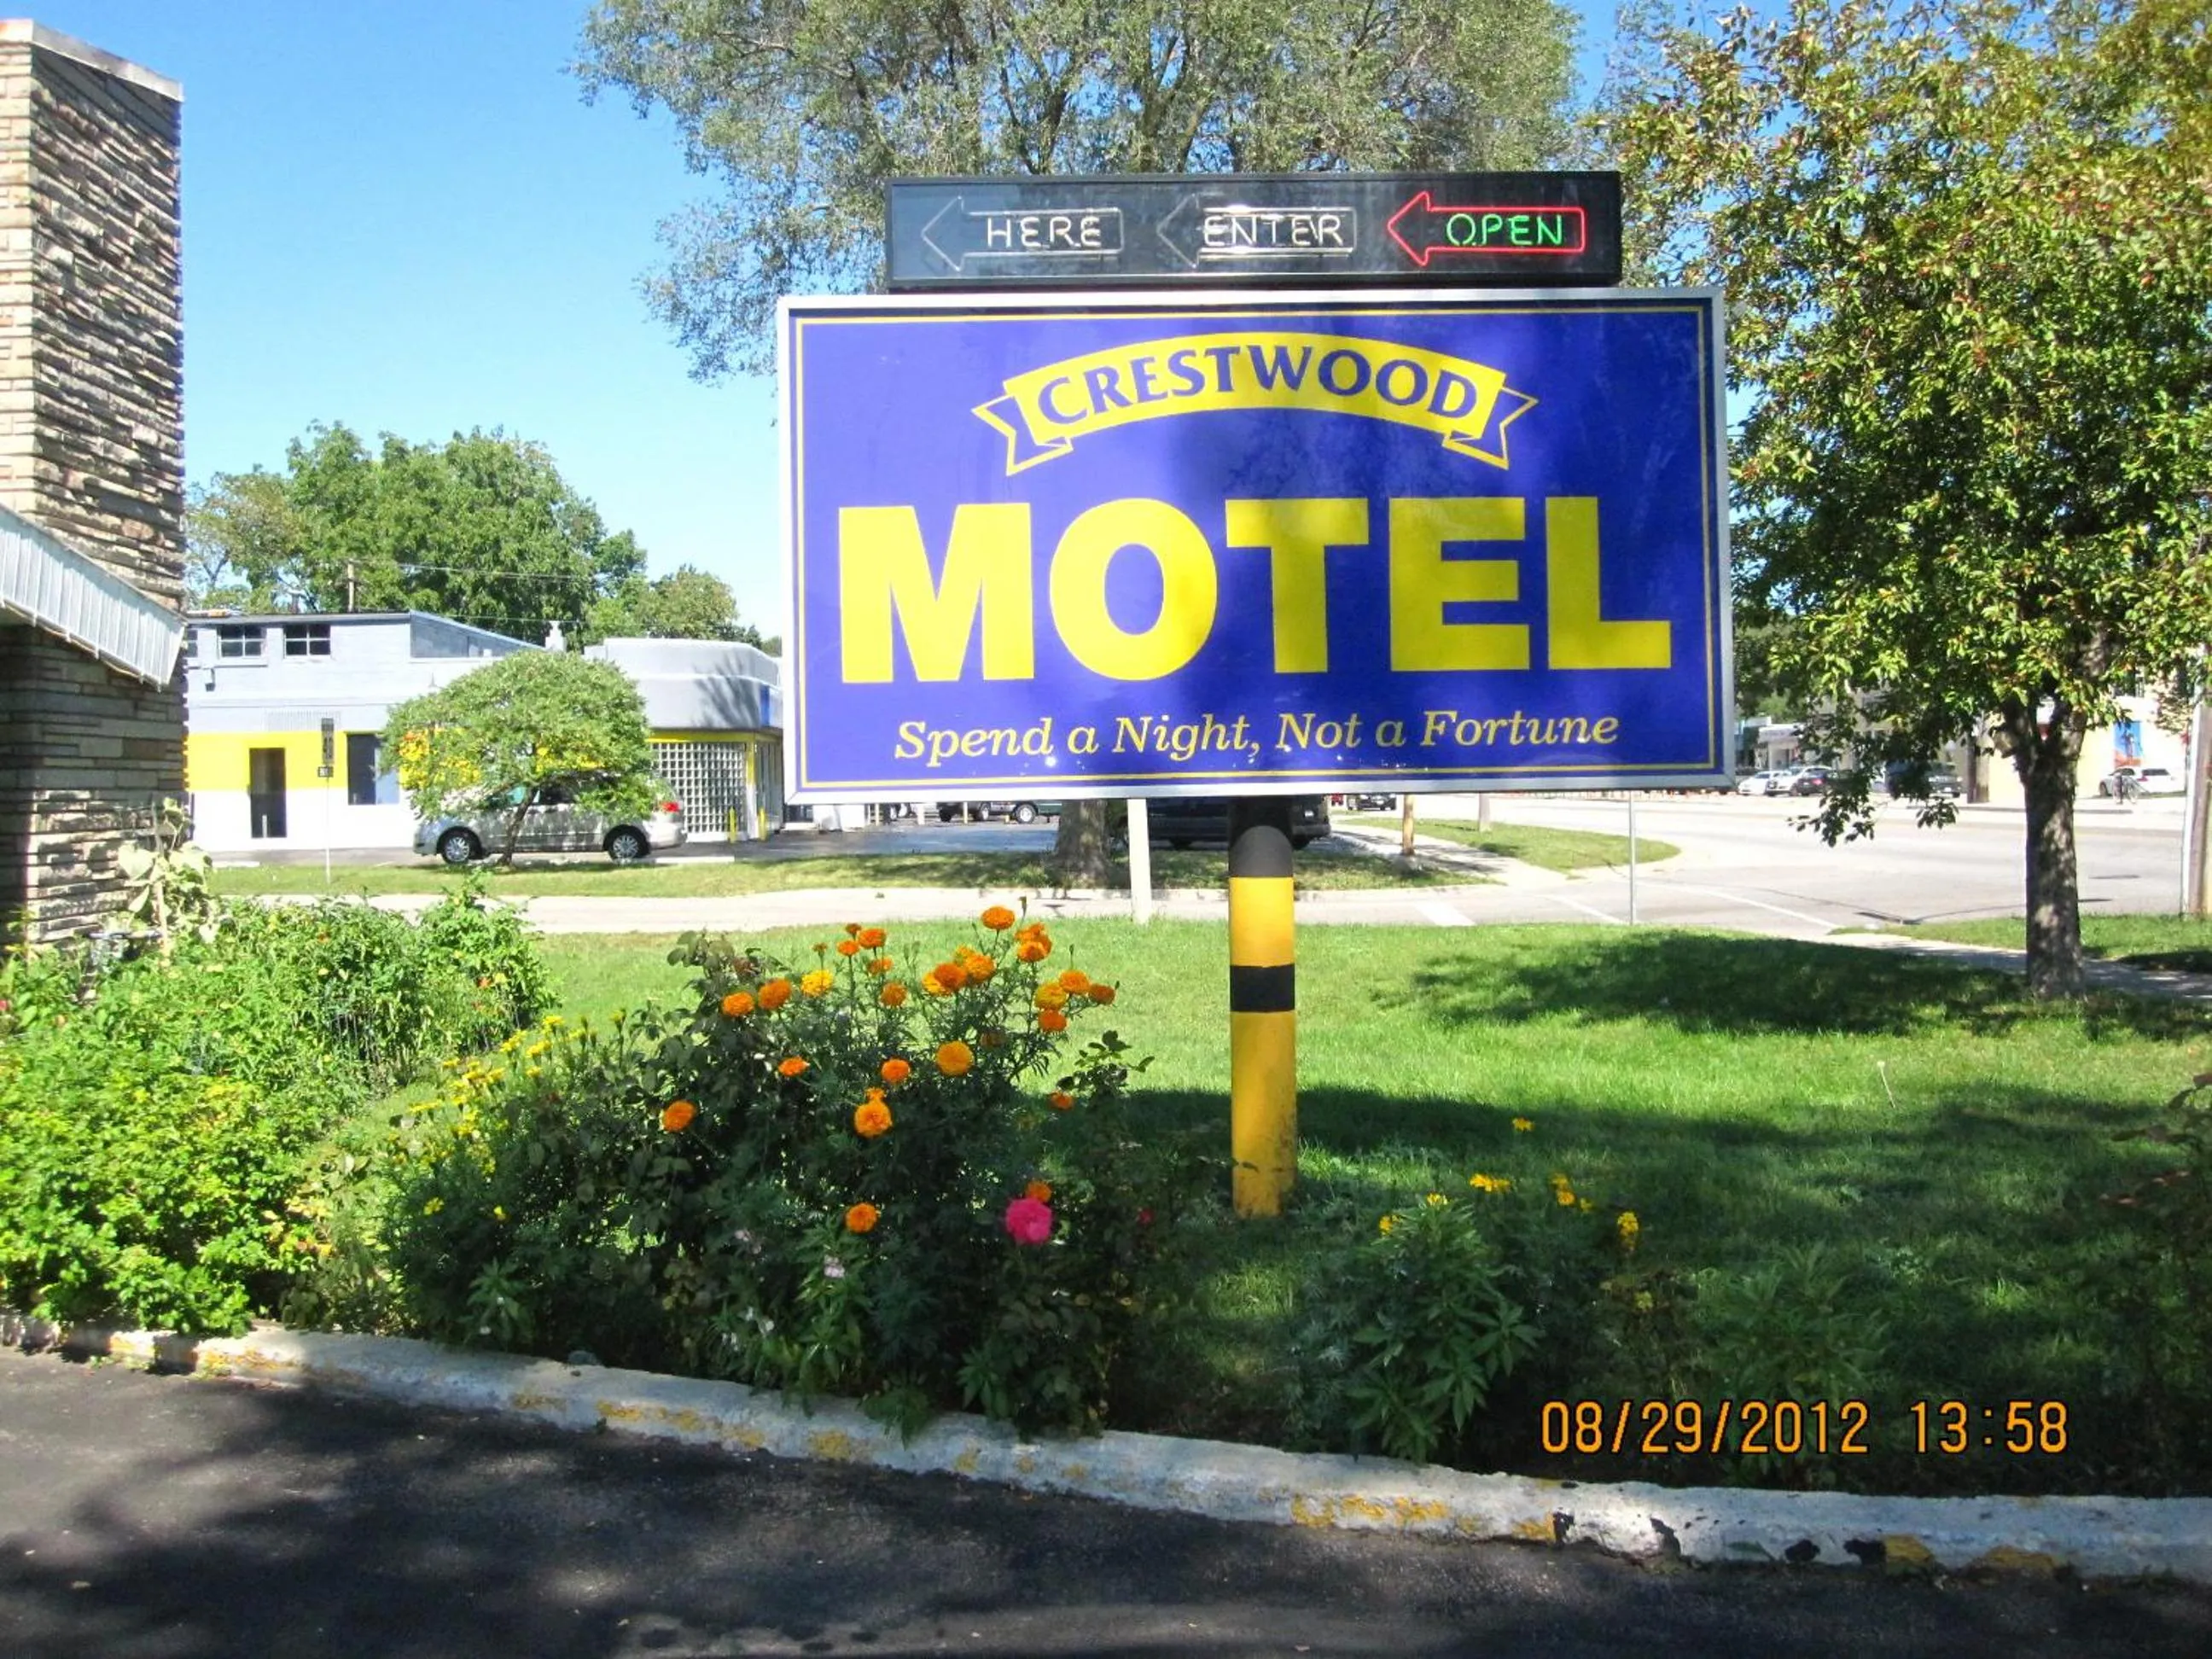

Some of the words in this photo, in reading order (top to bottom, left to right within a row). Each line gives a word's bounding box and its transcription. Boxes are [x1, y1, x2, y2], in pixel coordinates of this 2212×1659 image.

[987, 216, 1102, 247] HERE
[1203, 214, 1344, 246] ENTER
[1447, 212, 1562, 246] OPEN
[1038, 345, 1476, 425] CRESTWOOD
[839, 497, 1672, 684] MOTEL
[894, 717, 1054, 767] Spend
[1067, 725, 1099, 754] a
[1112, 713, 1260, 764] Night,
[1275, 712, 1363, 750] Not
[1375, 719, 1406, 747] a
[1420, 709, 1620, 747] Fortune
